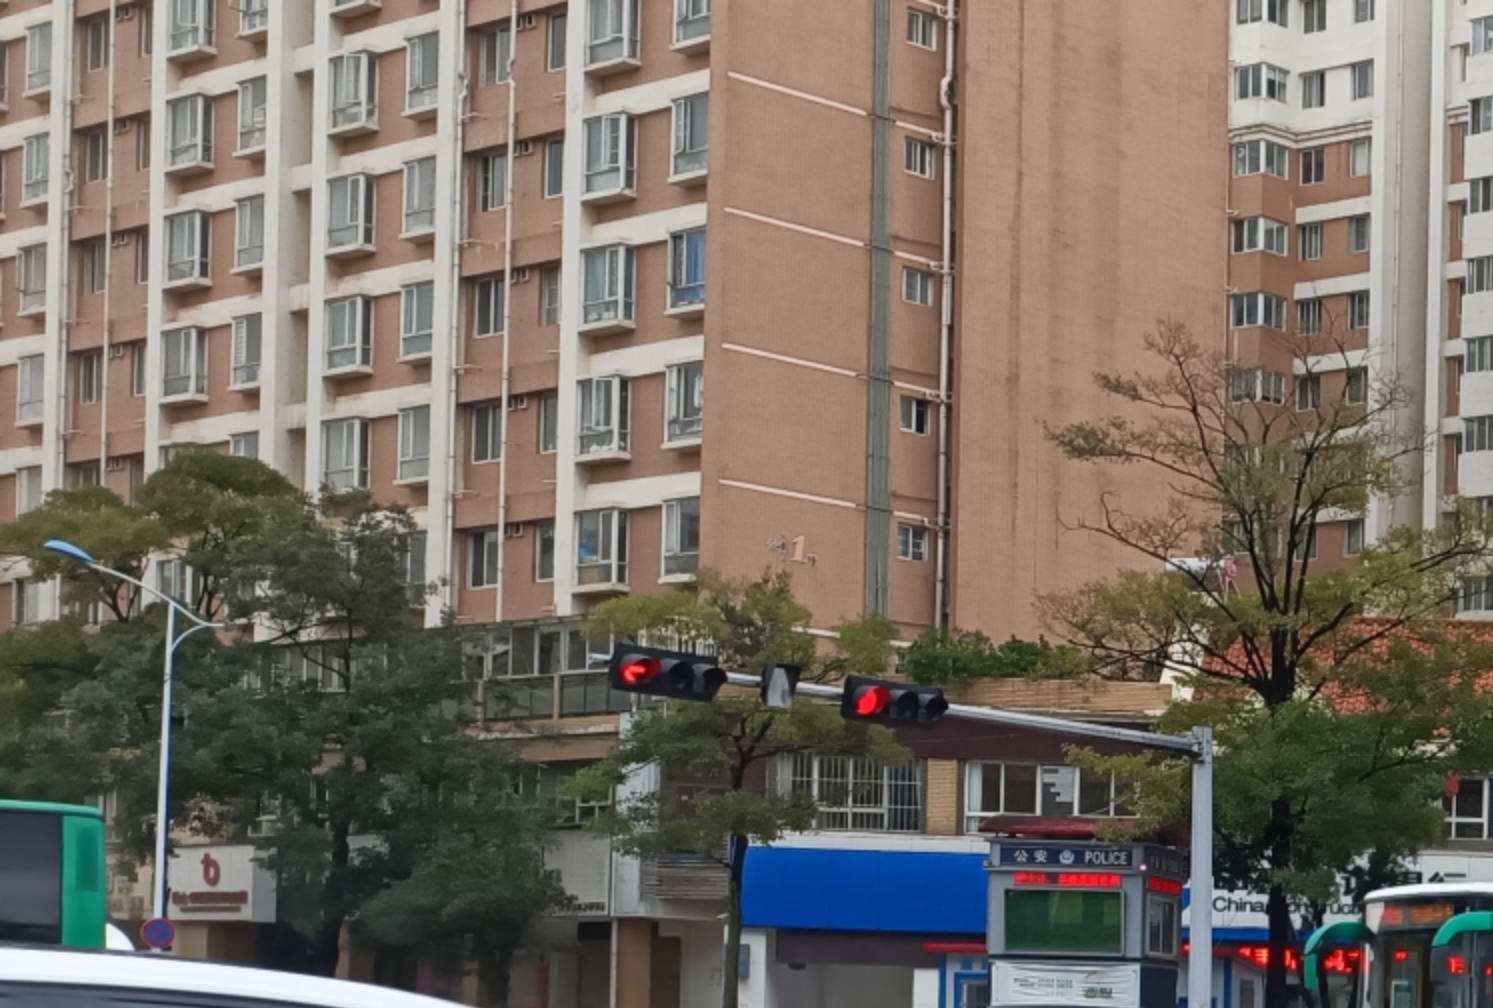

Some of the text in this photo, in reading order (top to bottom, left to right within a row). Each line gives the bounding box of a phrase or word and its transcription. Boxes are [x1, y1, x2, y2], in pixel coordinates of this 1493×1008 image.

[1013, 850, 1047, 863] 公安
[1084, 851, 1128, 865] POLICE
[1212, 896, 1266, 913] China
